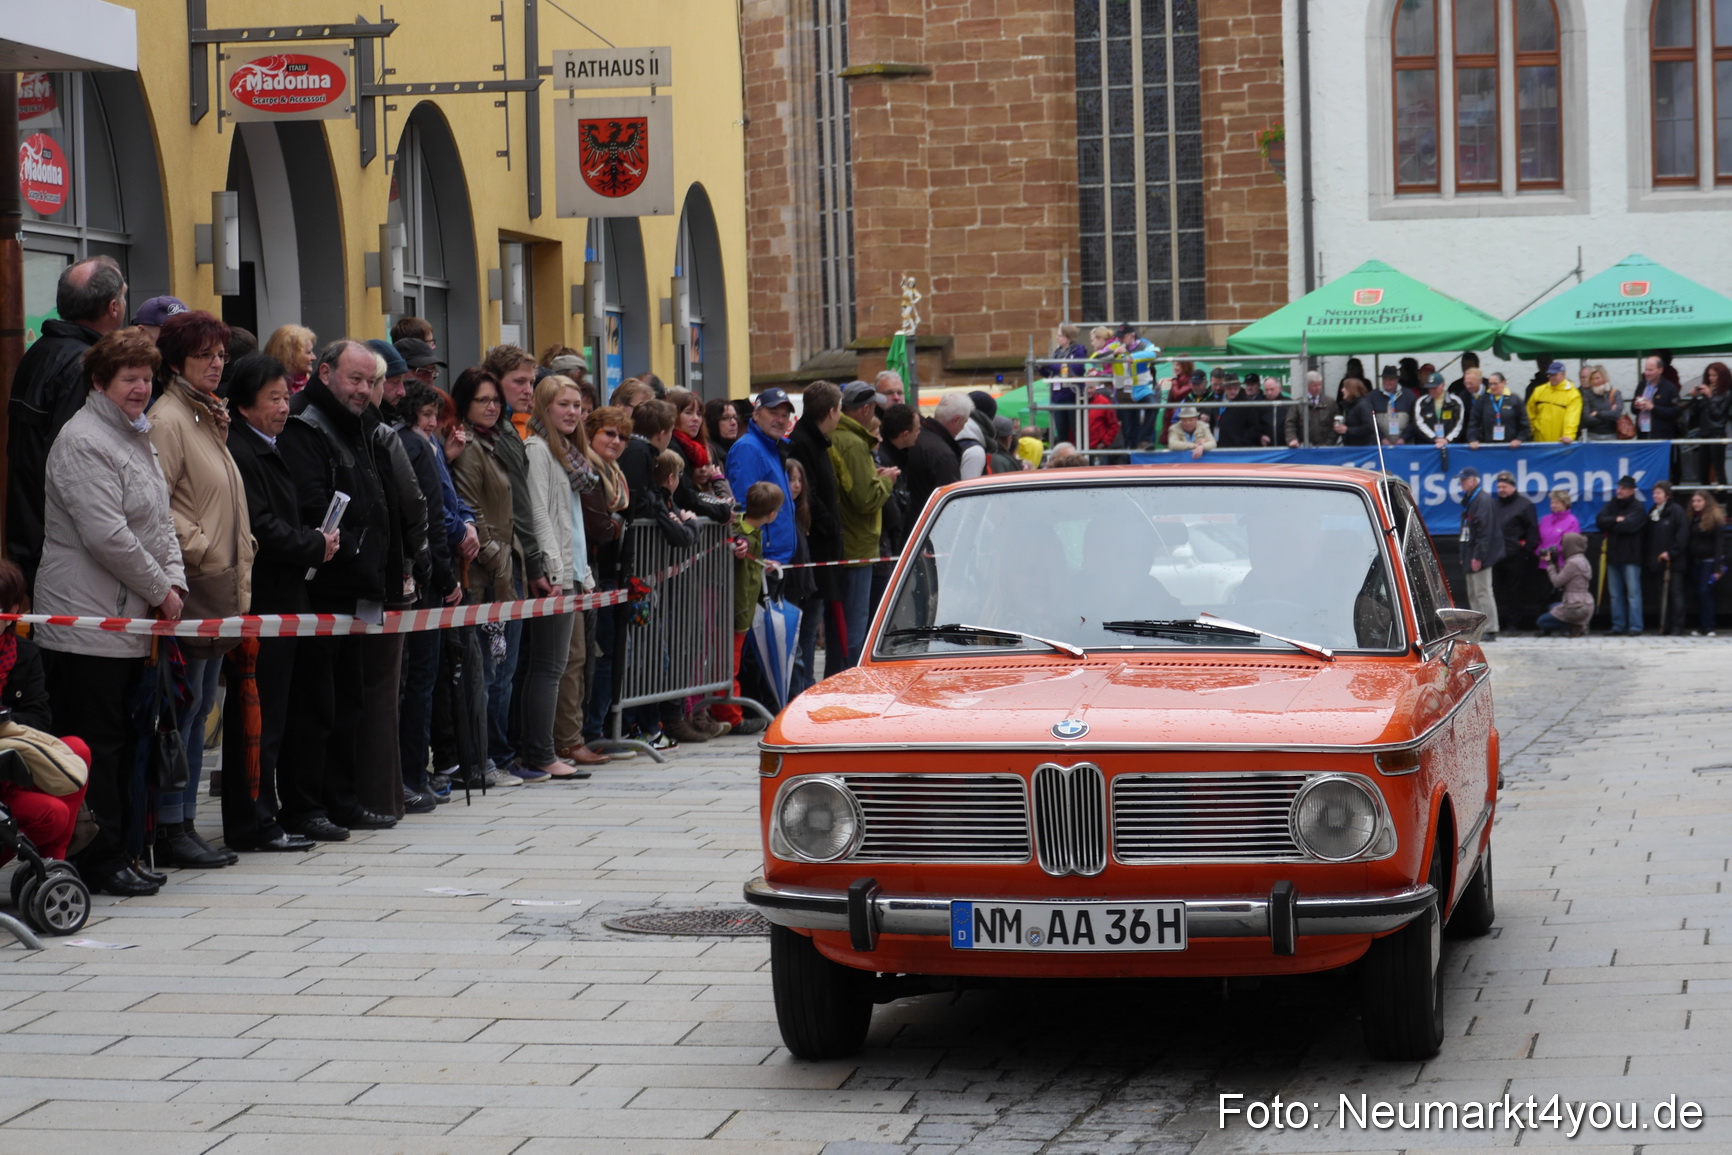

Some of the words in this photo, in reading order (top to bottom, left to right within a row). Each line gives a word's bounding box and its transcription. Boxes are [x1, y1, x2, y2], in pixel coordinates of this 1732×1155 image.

[565, 58, 645, 79] RATHAUS
[649, 58, 659, 76] II
[245, 71, 332, 92] Madonna
[252, 96, 279, 106] Scarpe
[280, 96, 287, 104] &
[289, 94, 326, 104] Accessori
[25, 156, 63, 185] Madonna
[1324, 307, 1410, 316] Neumarkter
[1575, 303, 1693, 320] Lammsbräu
[1592, 298, 1678, 310] Neumarkter
[1307, 312, 1423, 326] Lammsbräu
[973, 907, 1022, 944] NM
[1046, 909, 1096, 945] AA
[957, 930, 967, 941] D
